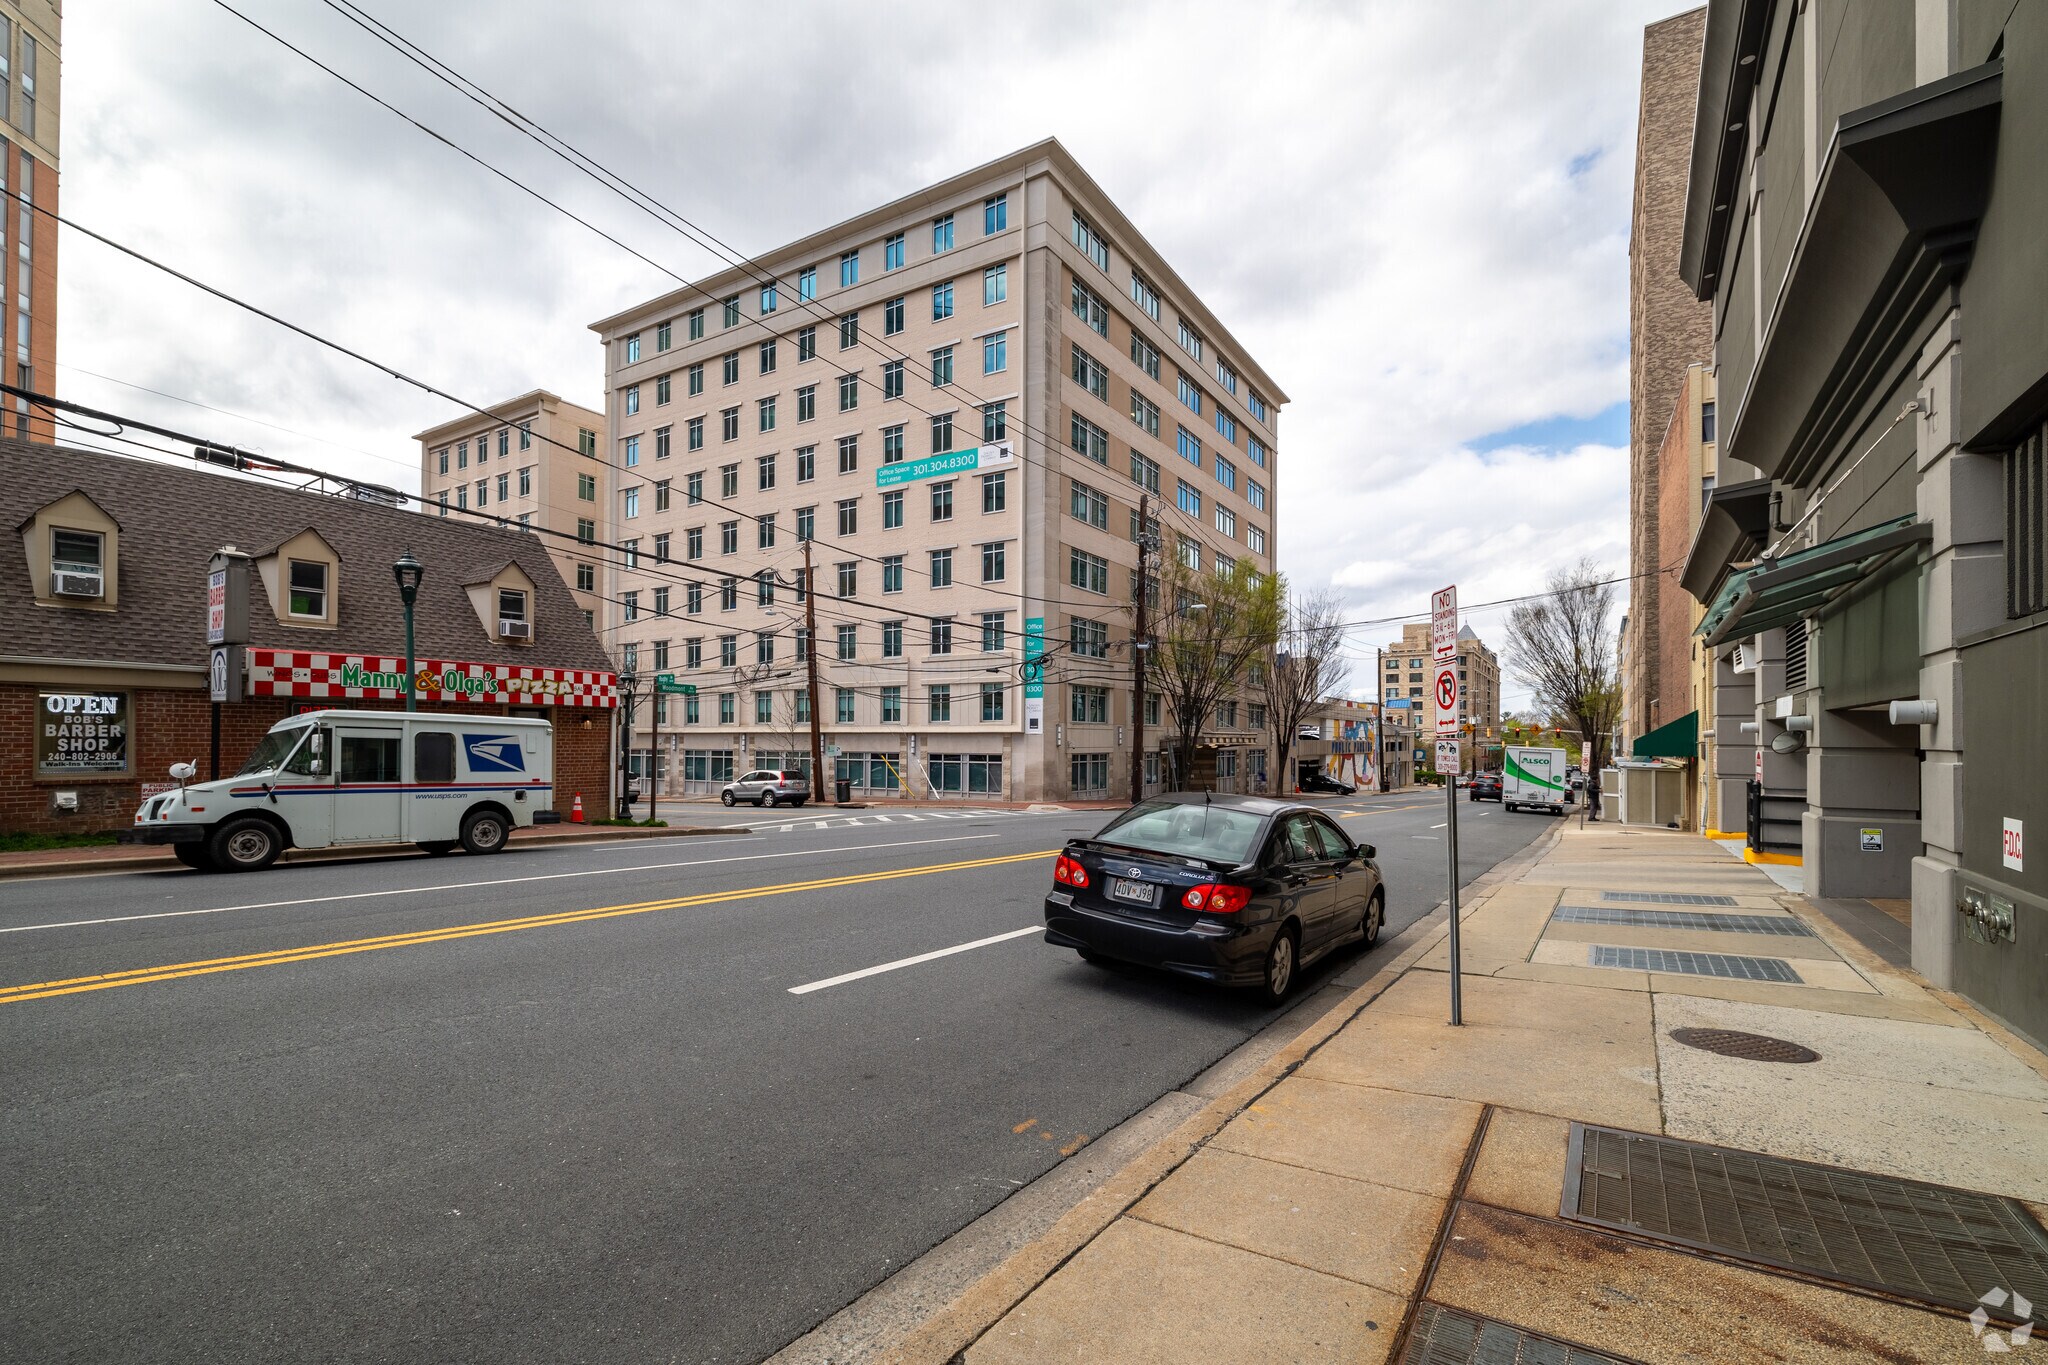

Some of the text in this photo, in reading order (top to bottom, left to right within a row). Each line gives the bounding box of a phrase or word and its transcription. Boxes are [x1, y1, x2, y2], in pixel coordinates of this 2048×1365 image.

[879, 468, 894, 477] Office
[894, 465, 910, 474] Space
[912, 454, 975, 476] 301.304.8300
[887, 475, 901, 483] Lease
[1439, 593, 1450, 609] NO
[1435, 607, 1455, 622] STANDING
[340, 662, 574, 697] Manny & Olga's PIZZA
[46, 695, 118, 714] OPEN
[64, 715, 103, 724] BOB'S
[45, 724, 121, 737] BARBER
[57, 738, 109, 752] SHOP
[48, 752, 117, 760] 240-802-2906
[1521, 757, 1549, 765] ALSCO
[415, 792, 467, 800] www.usps.com
[2003, 829, 2022, 859] F.D.C.
[1179, 871, 1206, 880] COROLLA
